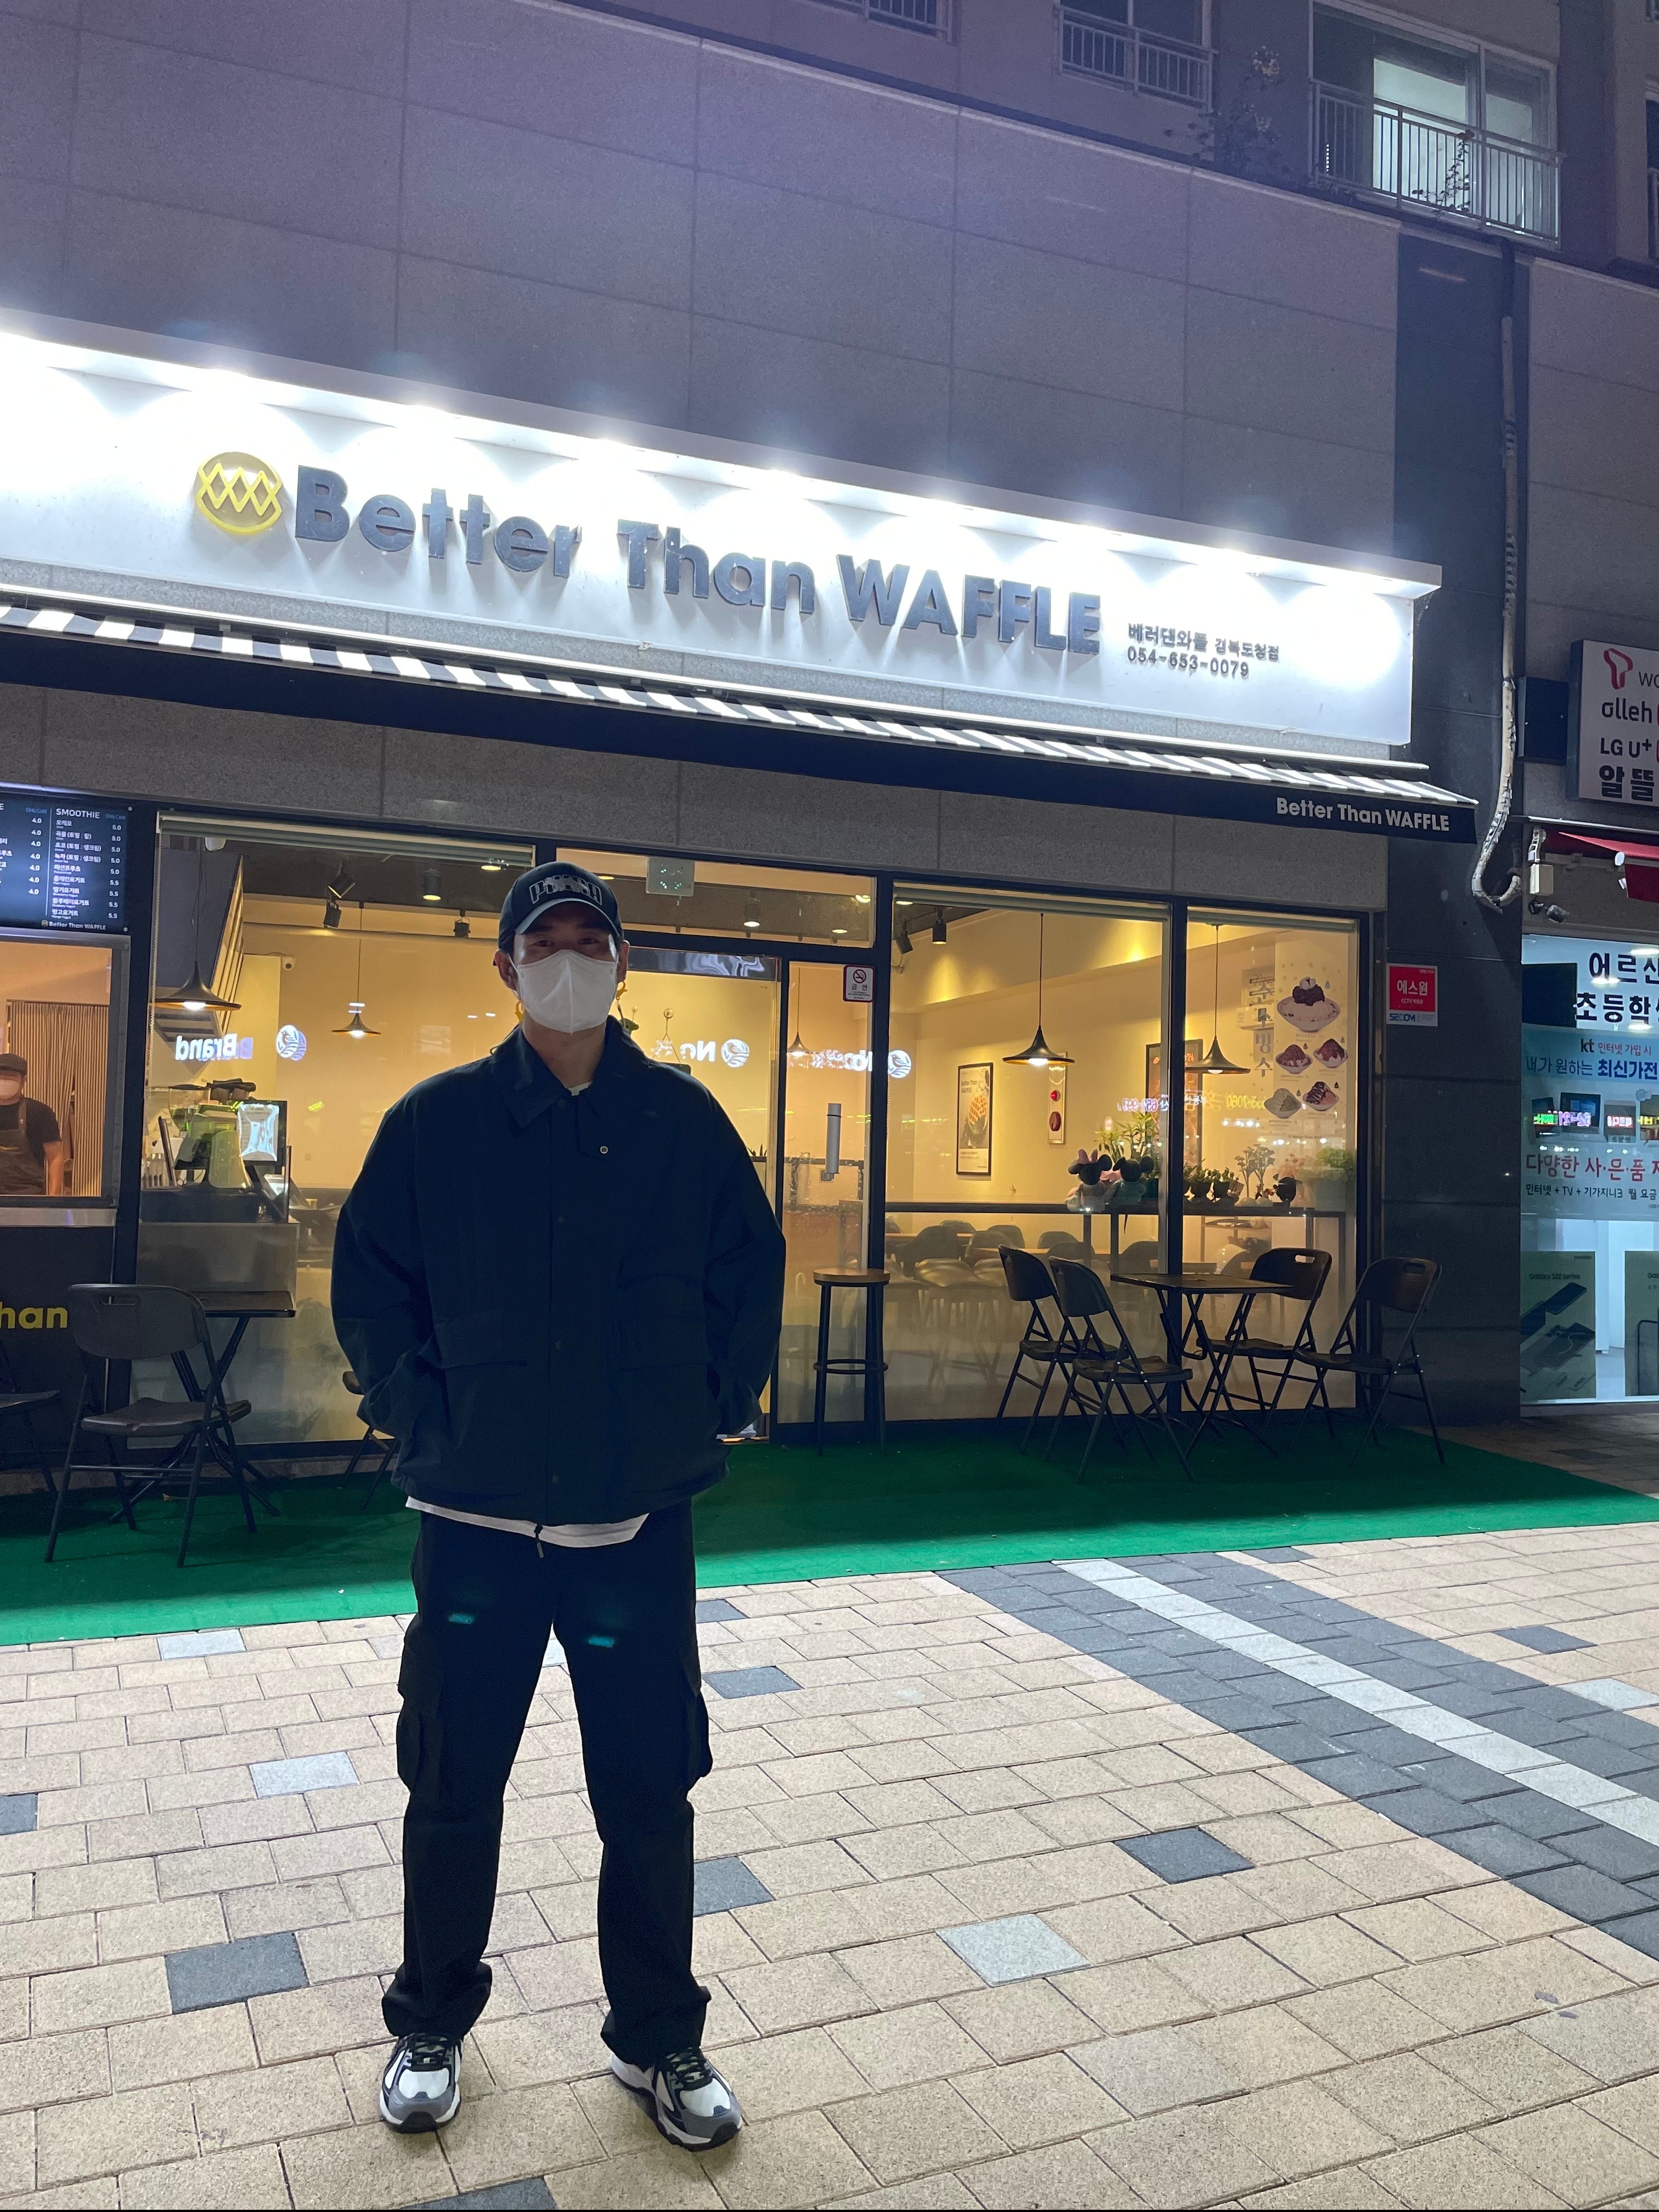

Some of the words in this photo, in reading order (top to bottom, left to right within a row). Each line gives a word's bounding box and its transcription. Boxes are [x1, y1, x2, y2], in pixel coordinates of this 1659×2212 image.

[295, 465, 582, 578] Better
[617, 519, 815, 614] Than
[836, 554, 1101, 655] WAFFLE
[1126, 645, 1249, 679] 054-653-0079
[1601, 697, 1652, 724] olleh
[1600, 737, 1623, 757] LG
[1599, 765, 1655, 802] 알뜰
[56, 808, 100, 819] SMOOTHIE
[1277, 797, 1333, 820] Better
[1338, 803, 1382, 825] Than
[1385, 809, 1449, 831] WAFFLE
[1397, 980, 1427, 996] 에스원
[1576, 992, 1659, 1025] 초등학
[1580, 1039, 1594, 1053] kt
[1625, 1045, 1641, 1057] 가입
[1526, 1057, 1552, 1073] 내가
[1555, 1059, 1593, 1076] 원하는
[1598, 1059, 1658, 1080] 최신가전
[1526, 1154, 1579, 1178] 다양한
[1562, 1186, 1573, 1196] TV
